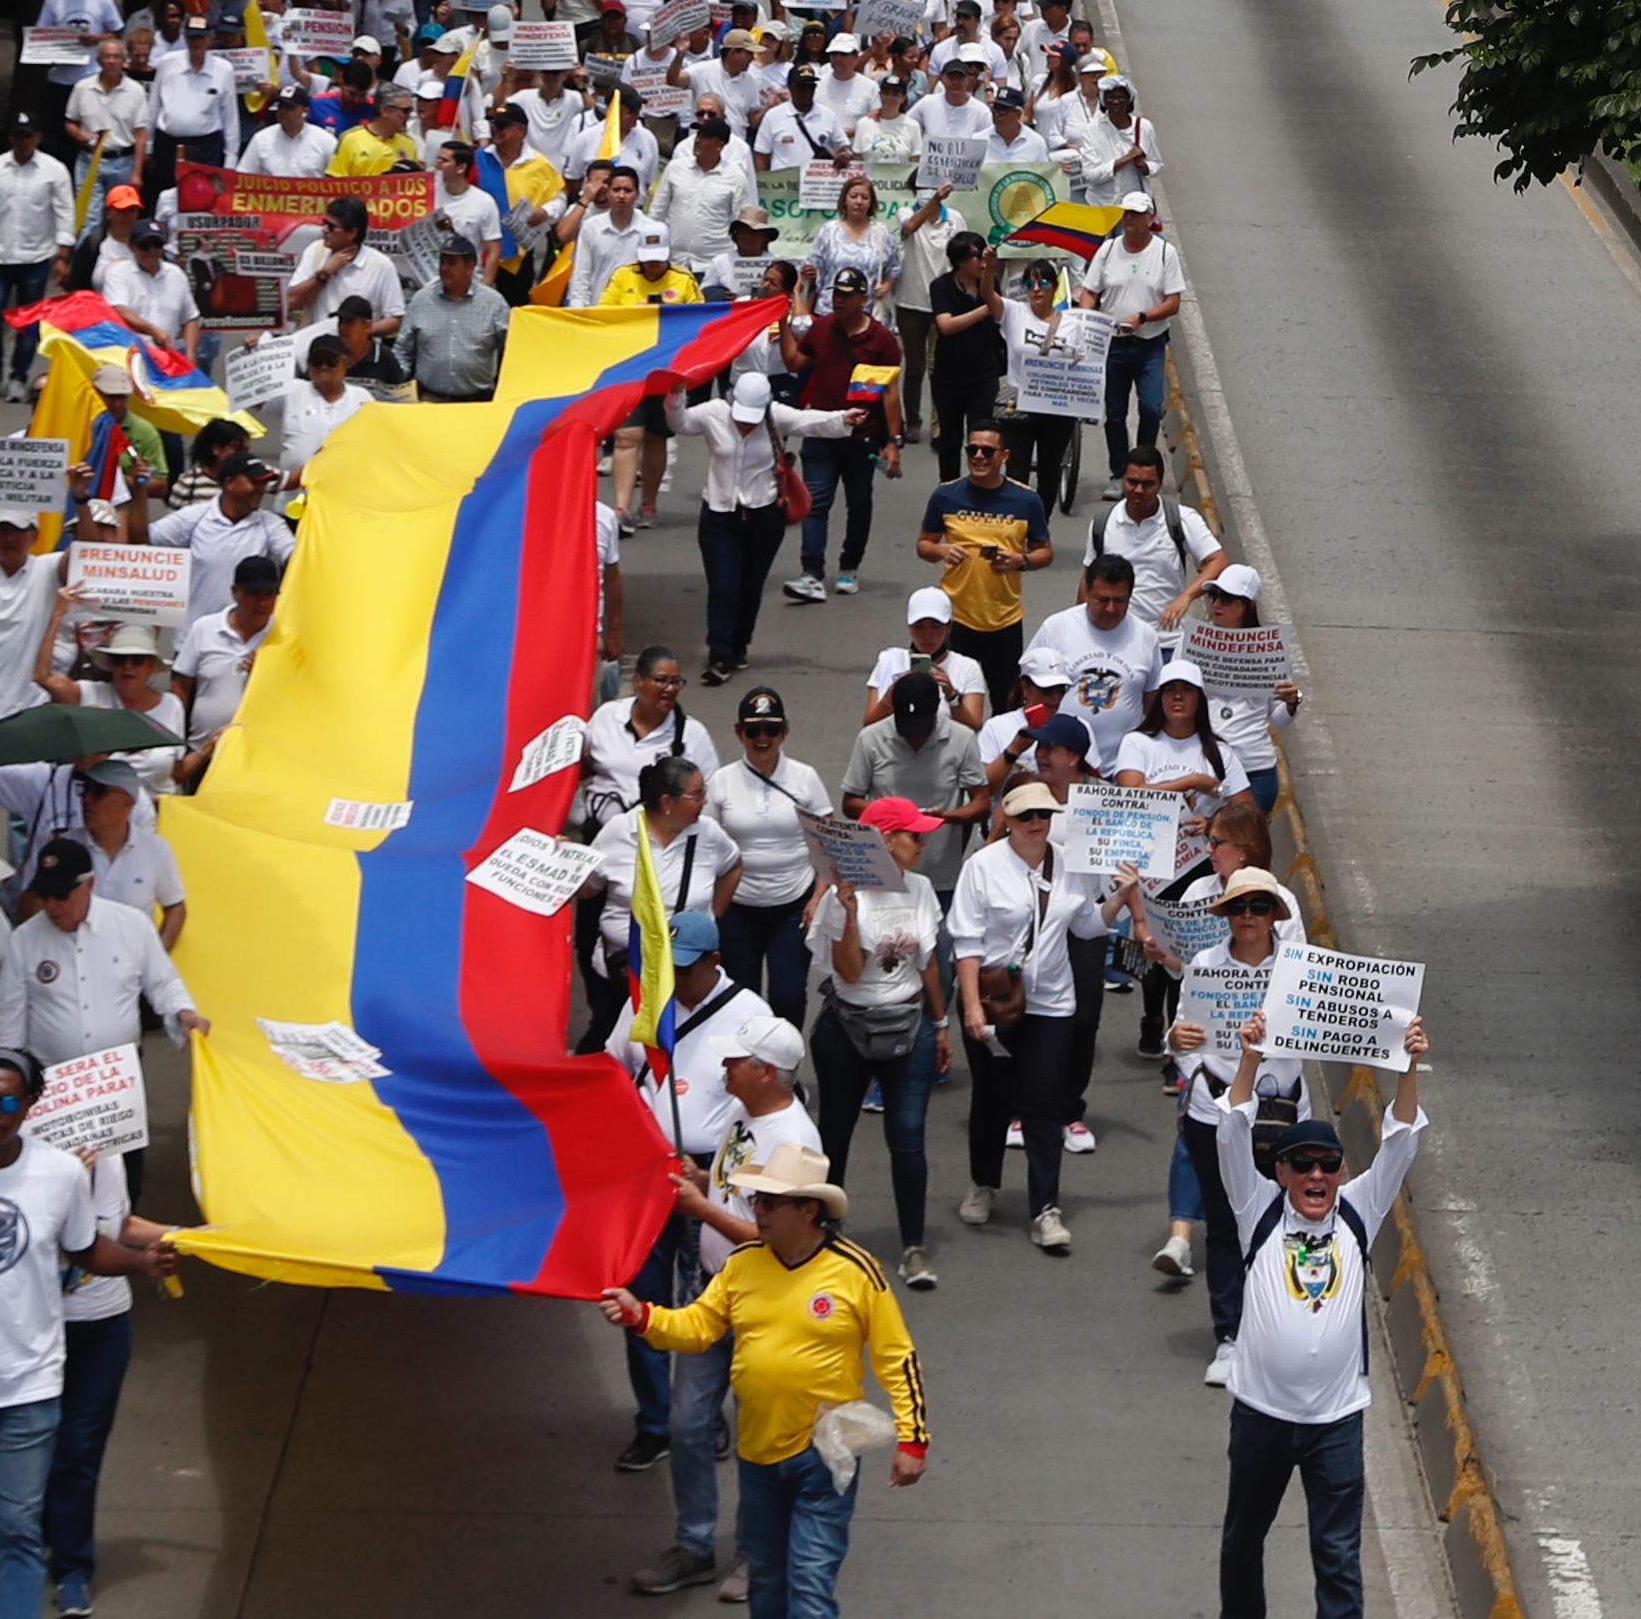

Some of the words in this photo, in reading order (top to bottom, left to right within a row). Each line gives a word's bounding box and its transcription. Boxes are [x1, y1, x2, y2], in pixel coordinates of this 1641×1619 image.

[928, 141, 943, 153] NO
[235, 174, 292, 192] JUICIO
[378, 181, 389, 195] A
[397, 178, 427, 197] LOS
[232, 192, 427, 218] ENMERADOS
[0, 457, 15, 466] LA
[16, 458, 62, 468] FUERZA
[17, 469, 25, 478] Y
[28, 470, 36, 479] A
[39, 470, 56, 480] LA
[5, 492, 52, 504] MILITAR
[956, 510, 1015, 525] GUESS
[78, 548, 184, 566] #RENUNCIE
[82, 564, 178, 582] MINSALUD
[1196, 626, 1280, 642] #RENUNCIE
[1190, 635, 1285, 654] MINDEFENSA
[1068, 652, 1101, 673] LIBERTAD
[1186, 648, 1221, 662] REDUCE
[1222, 656, 1263, 664] DEFENSA
[1263, 655, 1286, 663] PARA
[1213, 664, 1269, 672] CIUDADANOS
[1077, 785, 1122, 798] #AHORA
[1125, 789, 1178, 802] ATENTAN
[1101, 798, 1150, 810] CONTRA:
[1073, 808, 1111, 818] FONDOS
[1112, 810, 1124, 819] DE
[1092, 817, 1103, 826] EL
[1105, 818, 1138, 828] BANCO
[1140, 821, 1153, 829] DE
[1086, 827, 1098, 836] LA
[1097, 838, 1110, 846] SU
[1089, 847, 1102, 856] SU
[499, 848, 513, 860] EL
[515, 853, 568, 879] ESMAD
[1089, 857, 1103, 866] SU
[489, 858, 527, 879] QUEDA
[529, 875, 553, 891] CON
[490, 871, 553, 903] FUNCIONES
[1283, 947, 1303, 960] SIN
[1306, 951, 1416, 977] EXPROPIACIÓN
[1193, 968, 1249, 979] #AHORA
[1306, 969, 1333, 983] SIN
[1338, 974, 1380, 990] ROBO
[1190, 990, 1233, 1001] FONDOS
[1235, 992, 1251, 1001] DE
[1298, 979, 1385, 1003] PENSIONAL
[1216, 999, 1231, 1009] EL
[1286, 993, 1312, 1008] SIN
[1316, 1000, 1378, 1019] ABUSOS
[1381, 1009, 1393, 1020] A
[1210, 1010, 1226, 1019] LA
[1297, 1008, 1379, 1030] TENDEROS
[1225, 1021, 1241, 1030] SU
[1215, 1030, 1232, 1039] SU
[1291, 1025, 1317, 1040] SIN
[1322, 1031, 1363, 1045] PAGO
[1366, 1035, 1378, 1045] A
[1215, 1041, 1232, 1050] SU
[1274, 1036, 1391, 1060] DELINCUENTES
[54, 1057, 101, 1079] SERA
[102, 1050, 124, 1067] EL
[69, 1073, 97, 1091] DE
[99, 1066, 121, 1081] LA
[86, 1076, 136, 1102] PARA?
[98, 1108, 135, 1129] RIEGO
